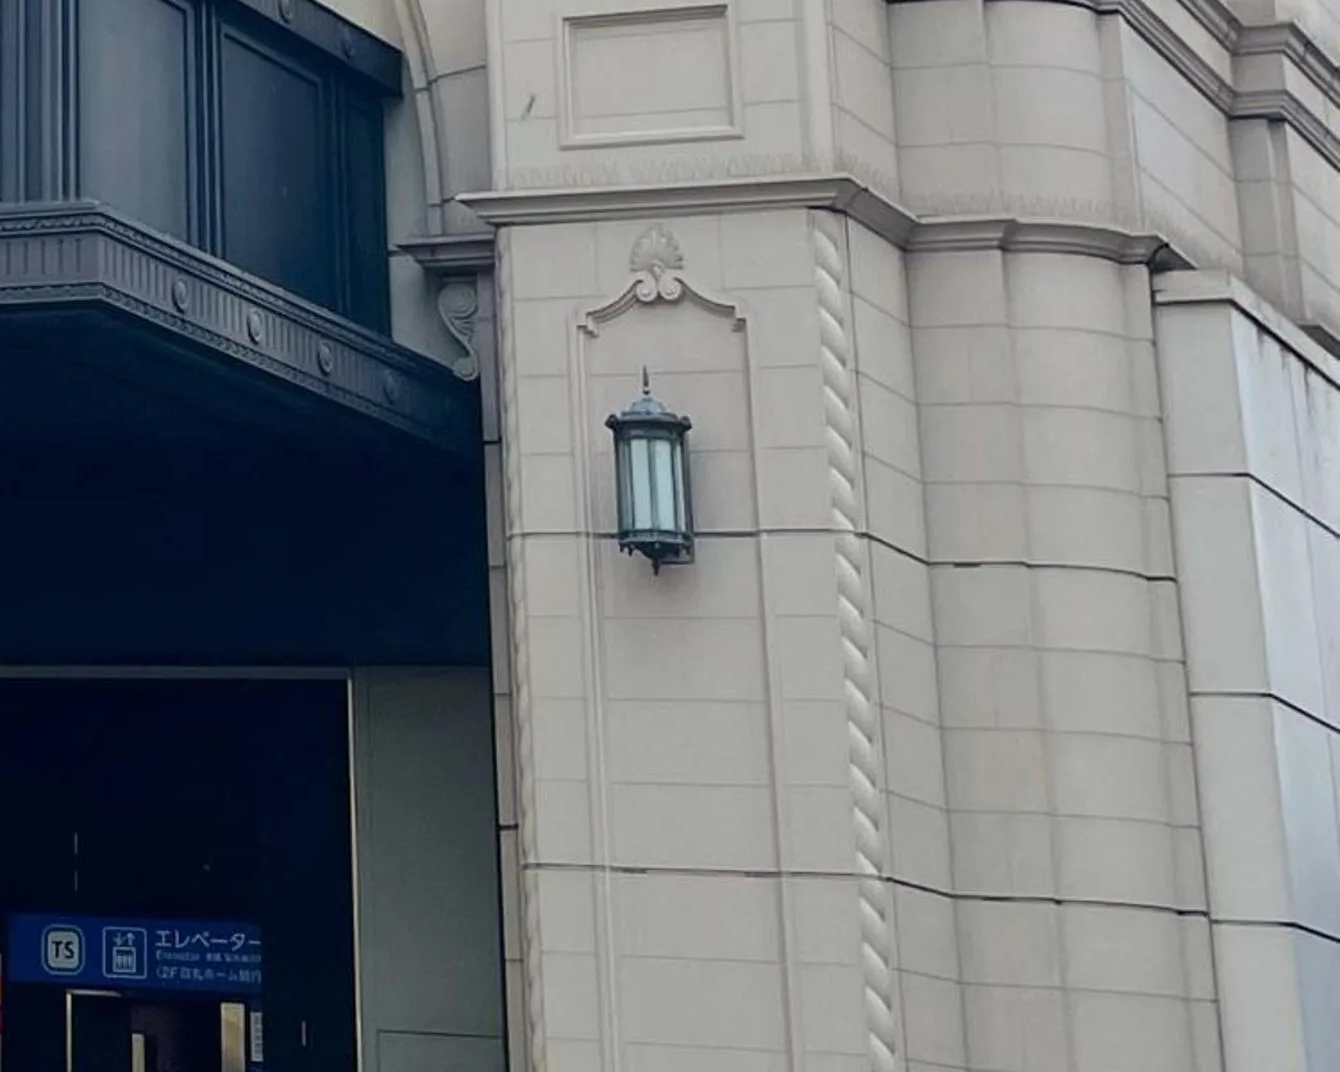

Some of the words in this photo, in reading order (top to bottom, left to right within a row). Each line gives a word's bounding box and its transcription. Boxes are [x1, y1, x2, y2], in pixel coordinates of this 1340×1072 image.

[51, 939, 75, 959] TS
[155, 929, 262, 952] エレベーター
